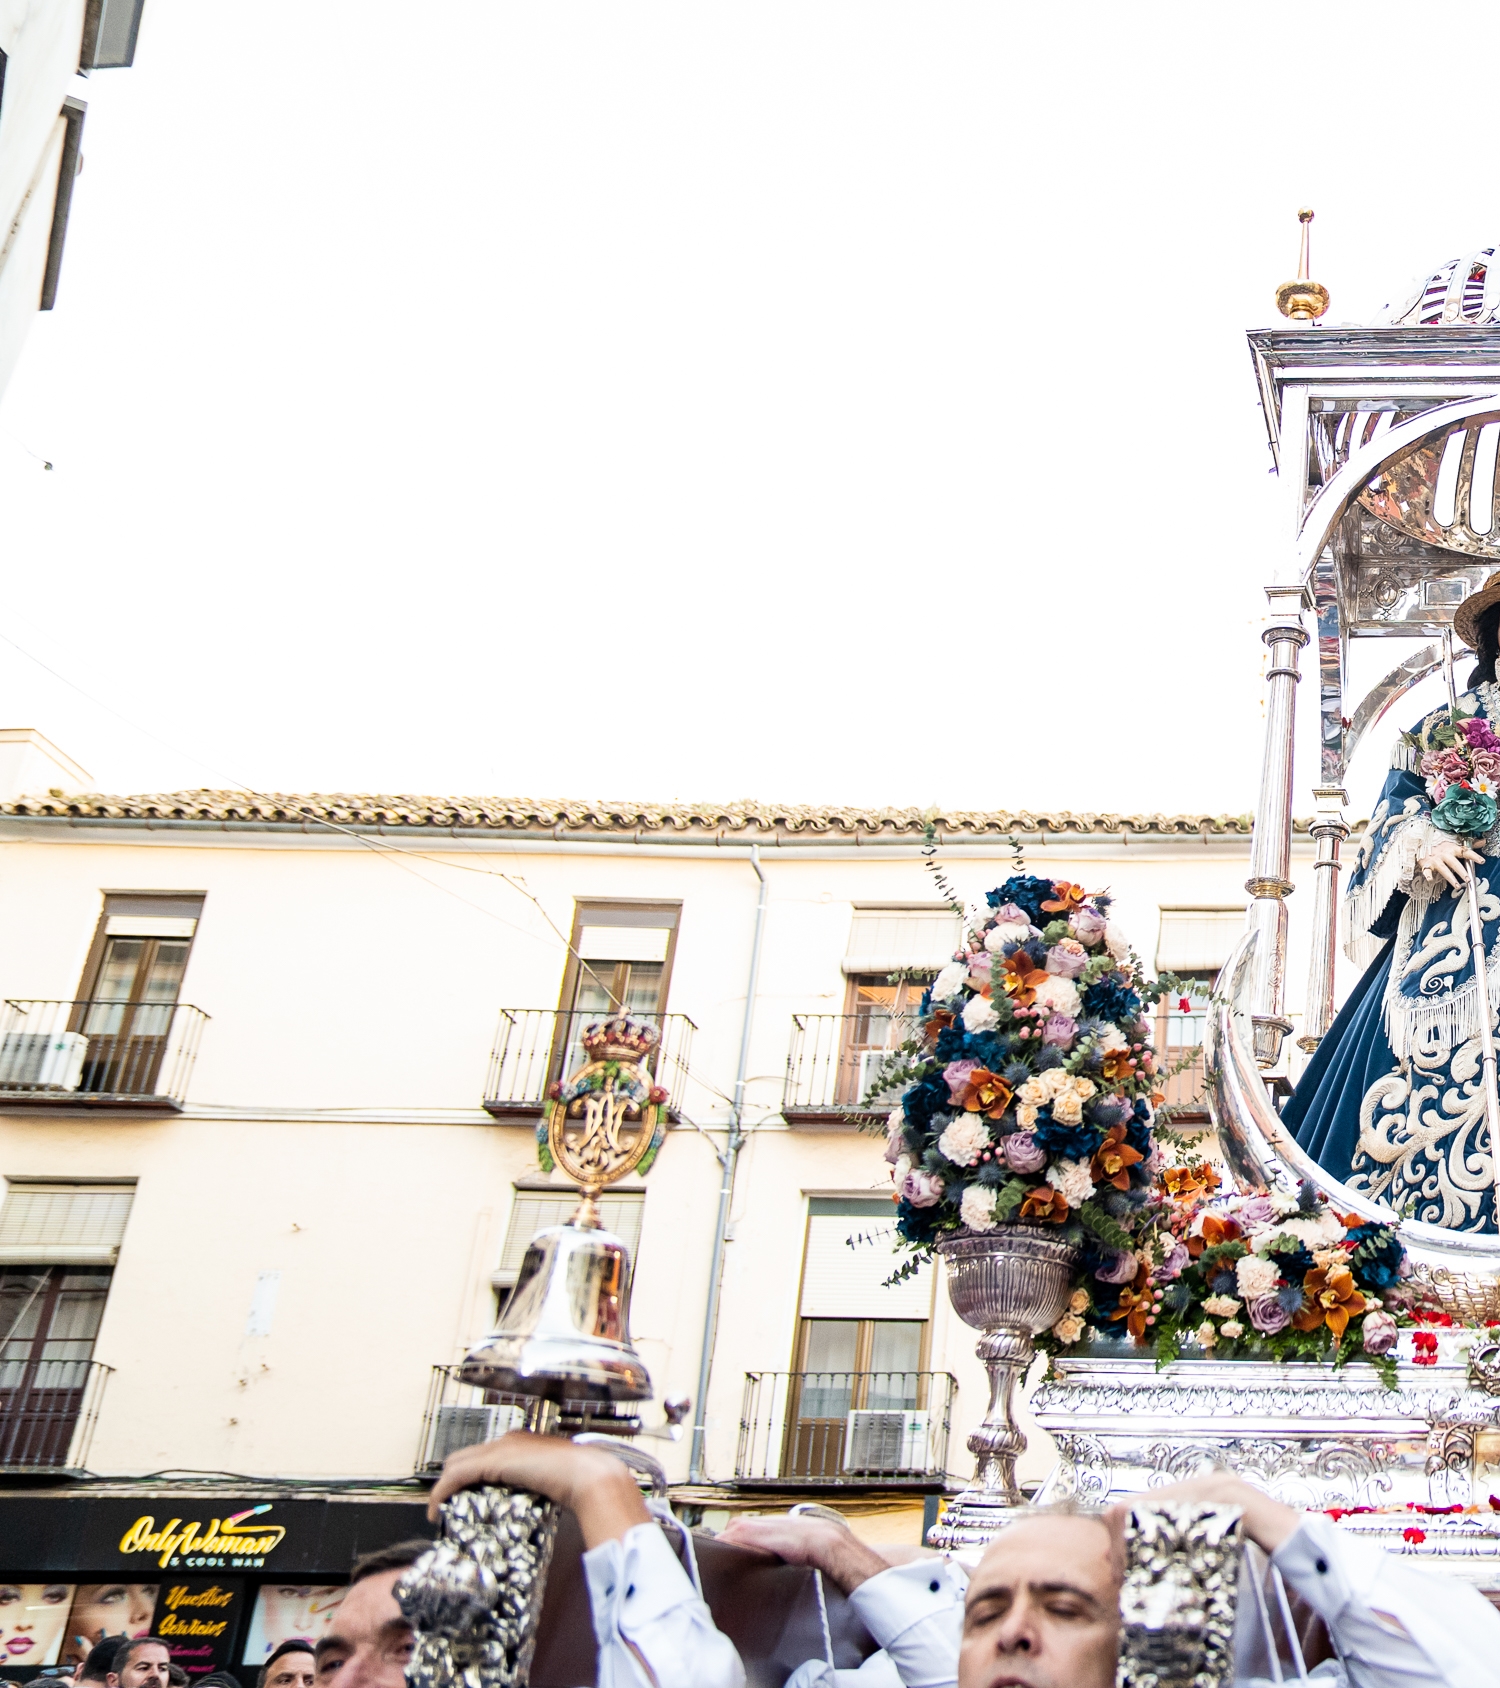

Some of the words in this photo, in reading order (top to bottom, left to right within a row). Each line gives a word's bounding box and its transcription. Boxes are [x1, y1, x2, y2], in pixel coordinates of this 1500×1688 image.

[185, 1557, 226, 1567] COOL
[231, 1557, 265, 1568] MAN
[164, 1585, 234, 1611] Nuestros
